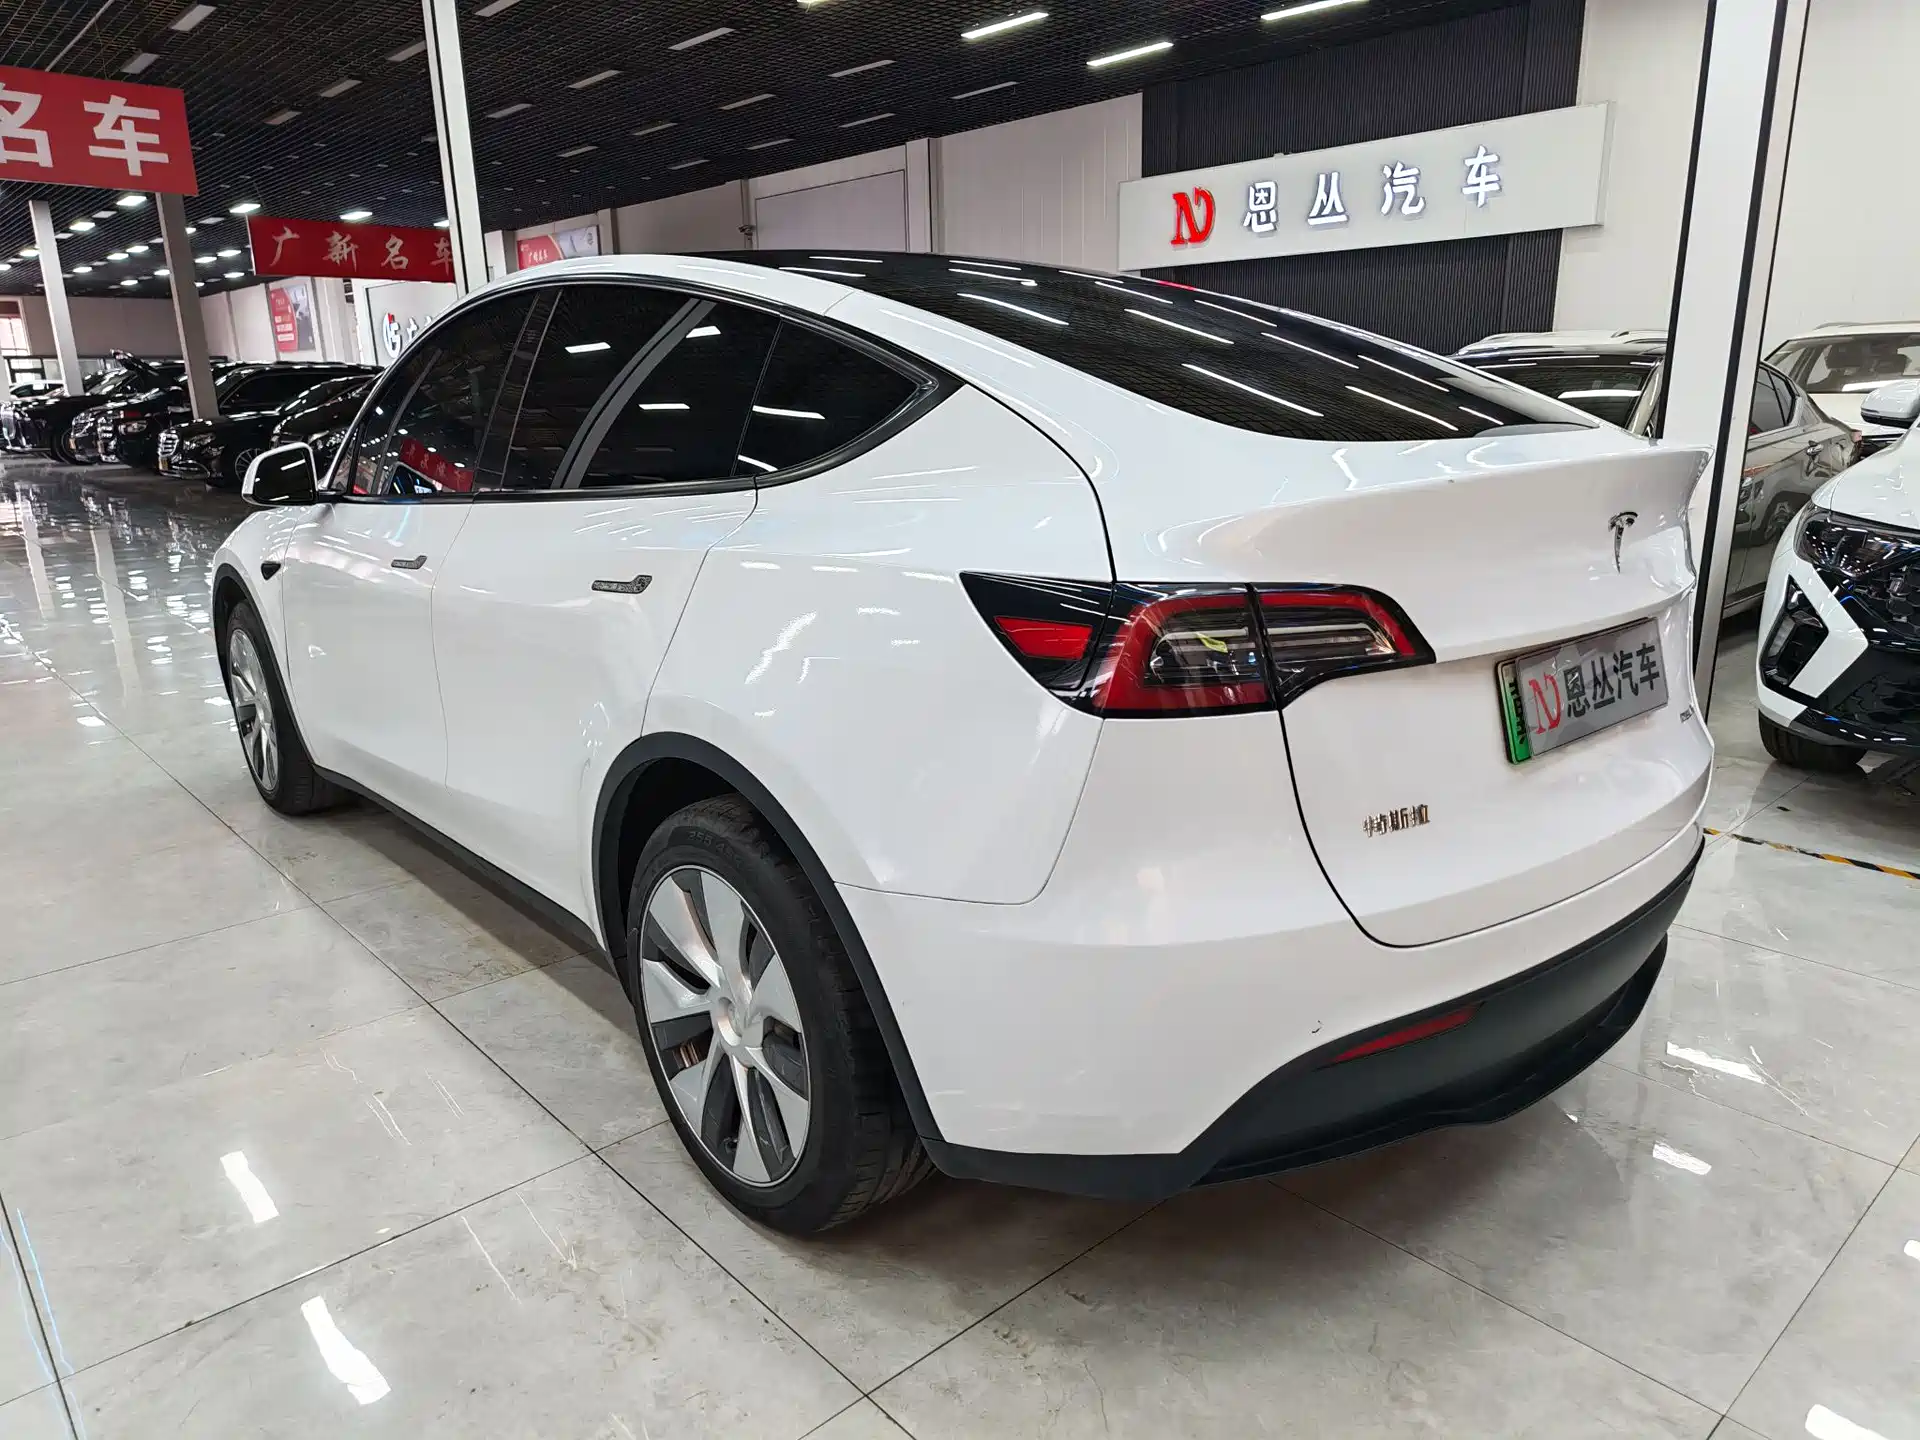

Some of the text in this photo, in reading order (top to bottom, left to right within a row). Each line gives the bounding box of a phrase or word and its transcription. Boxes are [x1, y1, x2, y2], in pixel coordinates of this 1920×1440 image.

[0, 82, 169, 176] 名车
[1243, 145, 1500, 233] 恩丛汽车
[270, 227, 453, 275] 广新名车
[1563, 643, 1660, 718] 恩丛汽车
